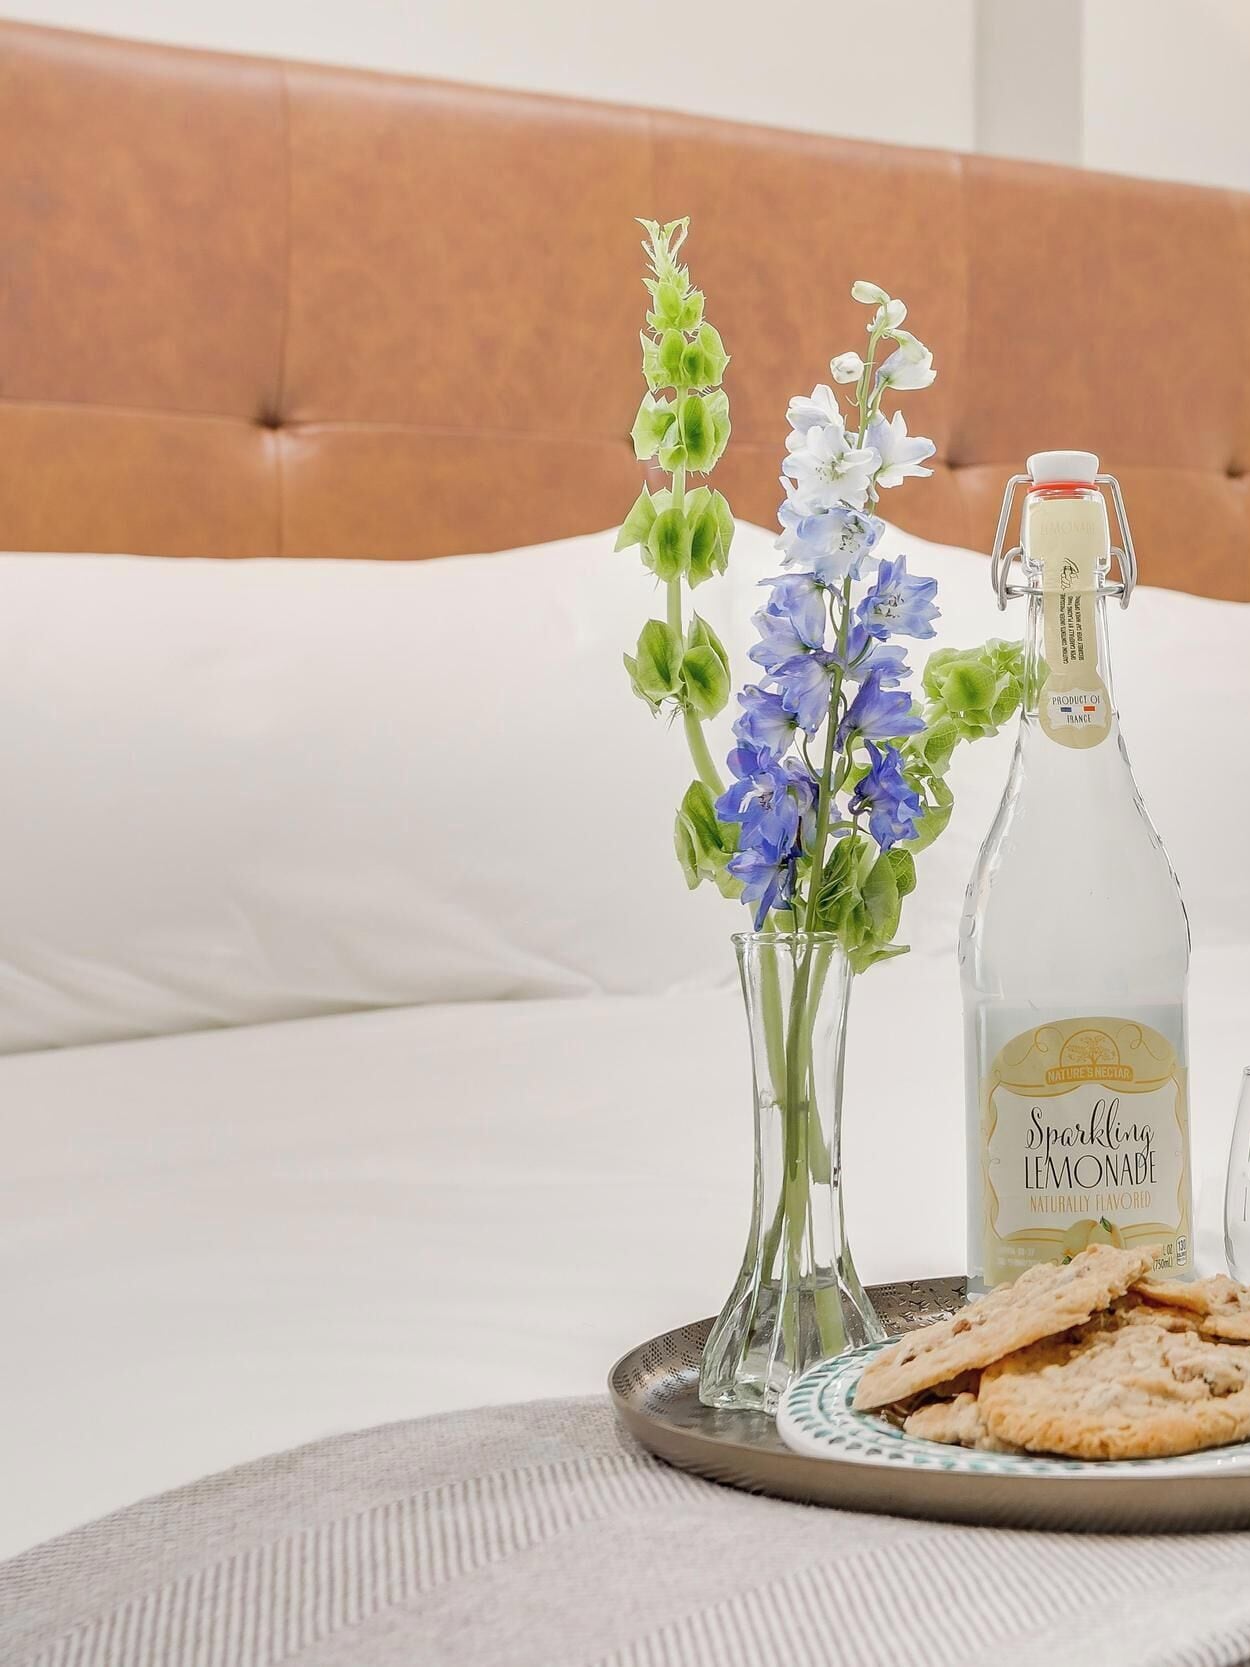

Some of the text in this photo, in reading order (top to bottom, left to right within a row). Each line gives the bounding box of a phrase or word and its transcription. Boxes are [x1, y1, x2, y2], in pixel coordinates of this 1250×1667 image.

[1052, 695, 1087, 705] PRODUCT
[1066, 714, 1092, 724] FRANCE
[1095, 1065, 1130, 1081] NECTAR
[1024, 1098, 1154, 1168] Sparkling
[1025, 1151, 1157, 1189] LEMONADE
[1030, 1191, 1151, 1213] NATURALLY FLAVORED
